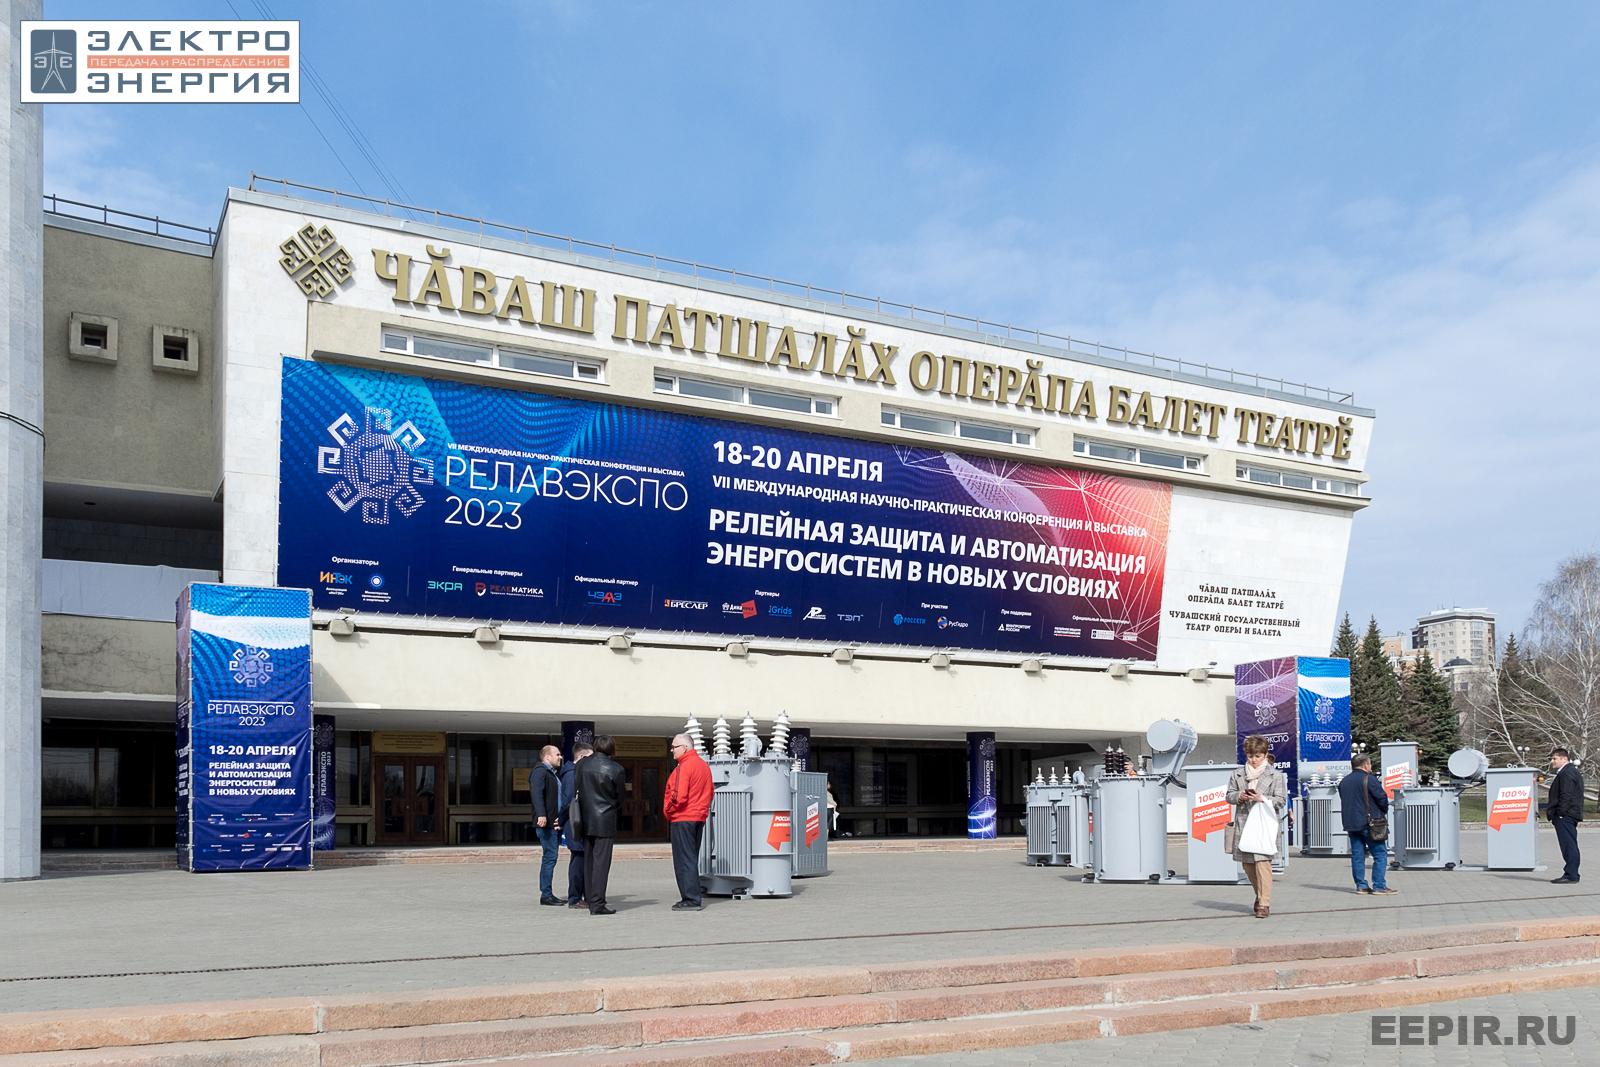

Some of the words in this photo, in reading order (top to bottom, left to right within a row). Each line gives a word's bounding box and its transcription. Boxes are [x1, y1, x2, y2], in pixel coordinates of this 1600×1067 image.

[1106, 384, 1227, 439] БАЛЕТ
[447, 443, 458, 451] VII
[458, 444, 520, 458] МЕЖДУНАРОДНАЯ
[522, 451, 599, 467] НАУЧНО-ПРАКТИЧЕСКАЯ
[601, 460, 646, 472] КОНФЕРЕНЦИЯ
[654, 467, 684, 476] ВЫСТАВКА
[714, 441, 780, 469] 18-20
[786, 450, 882, 482] АПРЕЛЯ
[446, 456, 688, 511] РЕЛАВЭКСПО
[713, 475, 730, 488] VII
[734, 478, 857, 504] МЕЖДУНАРОДНАЯ
[860, 493, 1000, 520] НАУЧНО-ПРАКТИЧЕСКАЯ
[1004, 510, 1082, 530] КОНФЕРЕНЦИЯ
[1084, 521, 1092, 531] И
[1094, 522, 1148, 538] ВЫСТАВКА
[444, 496, 522, 530] 2023
[710, 508, 844, 543] РЕЛЕЙНАЯ
[850, 524, 945, 554] ЗАЩИТА
[950, 535, 966, 555] И
[970, 537, 1146, 575] АВТОМАТИЗАЦИЯ
[332, 556, 379, 566] Организаторы
[494, 570, 522, 578] партнеры
[707, 542, 902, 580] ЭНЕРГОСИСТЕМ
[908, 561, 922, 582] В
[928, 563, 1006, 590] НОВЫХ
[1012, 571, 1120, 600] УСЛОВИЯХ
[616, 579, 639, 587] партнер
[755, 590, 780, 598] Партнеры
[670, 600, 708, 610] БРЕСЛЕР
[1228, 598, 1253, 608] БАЛЕТ
[1170, 610, 1220, 622] ЧУВАШСКИЙ
[1224, 615, 1300, 628] ГОСУДАРСТВЕННЫЙ
[1186, 623, 1210, 632] ТЕАТР
[1214, 626, 1242, 634] ОПЕРЫ
[1252, 628, 1282, 637] БАЛЕТА
[208, 704, 294, 716] РЕЛАВЭКСПО
[239, 717, 266, 726] 2023
[209, 746, 243, 755] 18-20
[246, 746, 296, 756] АПРЕЛЯ
[209, 761, 254, 770] РЕЛЕЙНАЯ
[256, 762, 290, 770] ЗАЩИТА
[217, 771, 292, 779] АВТОМАТИЗАЦИЯ
[1198, 791, 1225, 803] 100%
